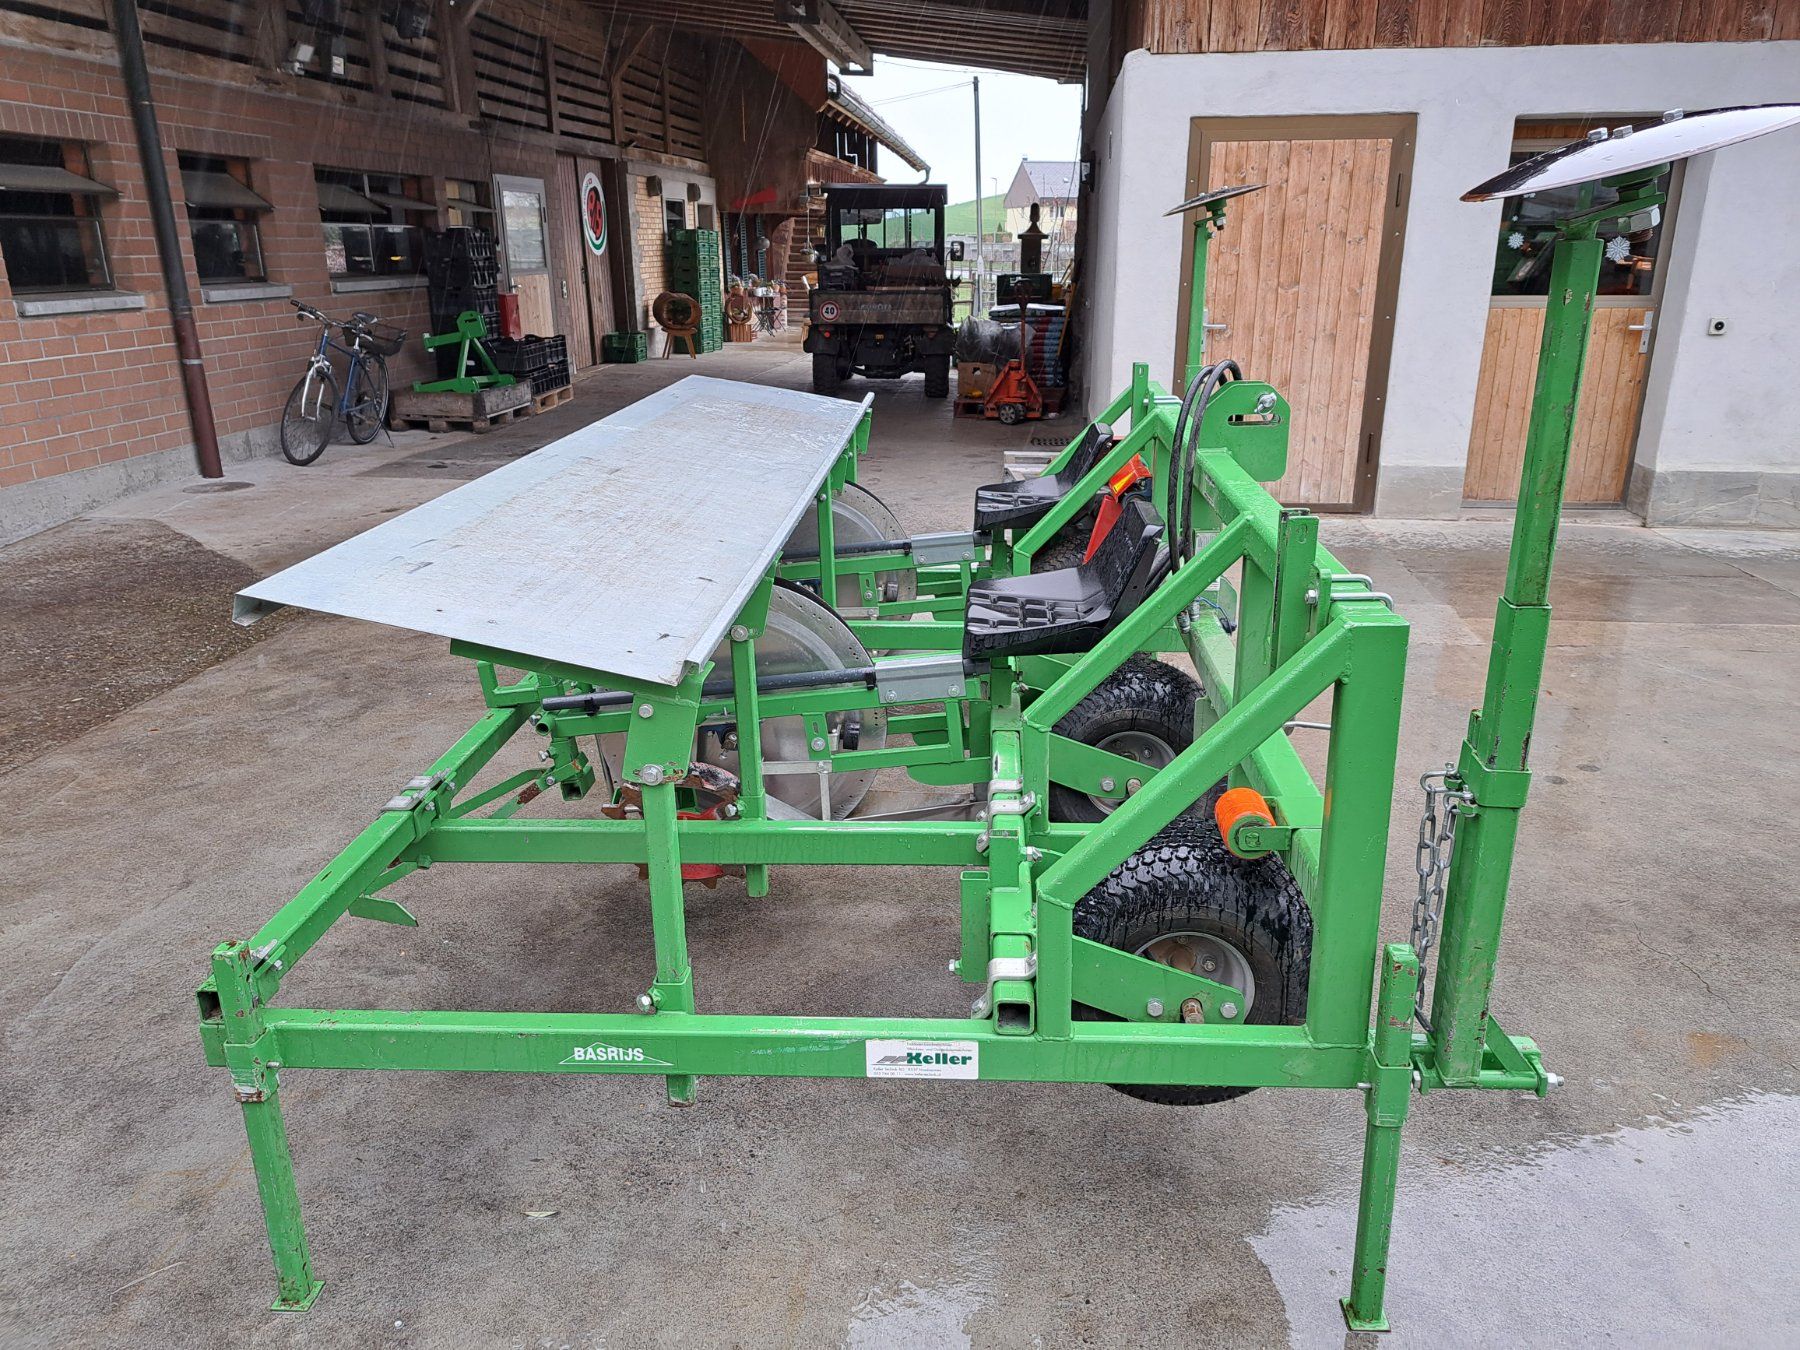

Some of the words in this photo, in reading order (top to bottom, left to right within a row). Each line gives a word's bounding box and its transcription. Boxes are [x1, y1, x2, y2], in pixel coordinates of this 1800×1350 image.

[824, 306, 835, 315] 40
[573, 1047, 644, 1061] BASRIJS
[906, 1052, 972, 1065] Keller
